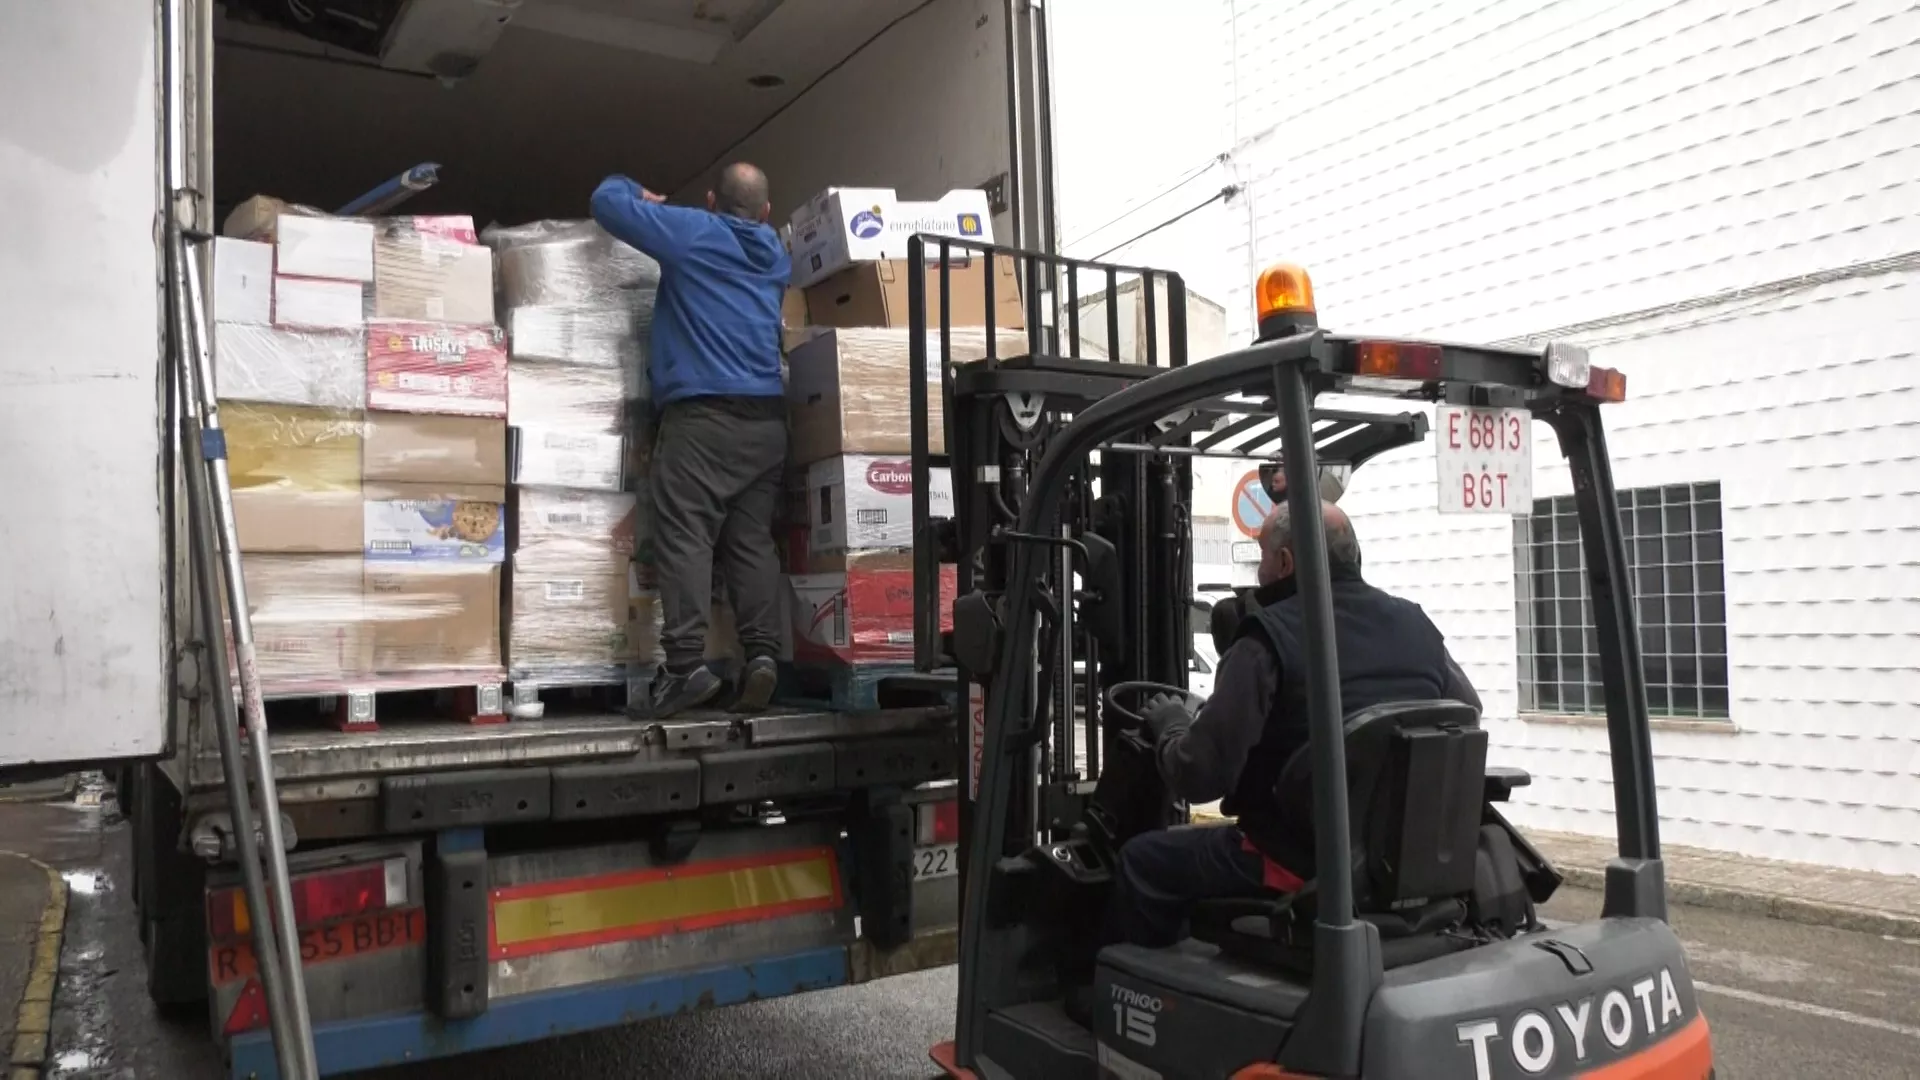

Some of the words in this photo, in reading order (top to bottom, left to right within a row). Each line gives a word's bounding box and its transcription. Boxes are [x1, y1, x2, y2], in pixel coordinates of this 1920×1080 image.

[1449, 412, 1461, 449] E
[1469, 413, 1521, 451] 6813
[871, 470, 912, 482] Carbon
[1463, 473, 1508, 508] BGT
[913, 848, 959, 877] 22
[217, 949, 238, 979] R
[1113, 1003, 1157, 1047] 15
[1457, 967, 1683, 1080] TOYOTA
